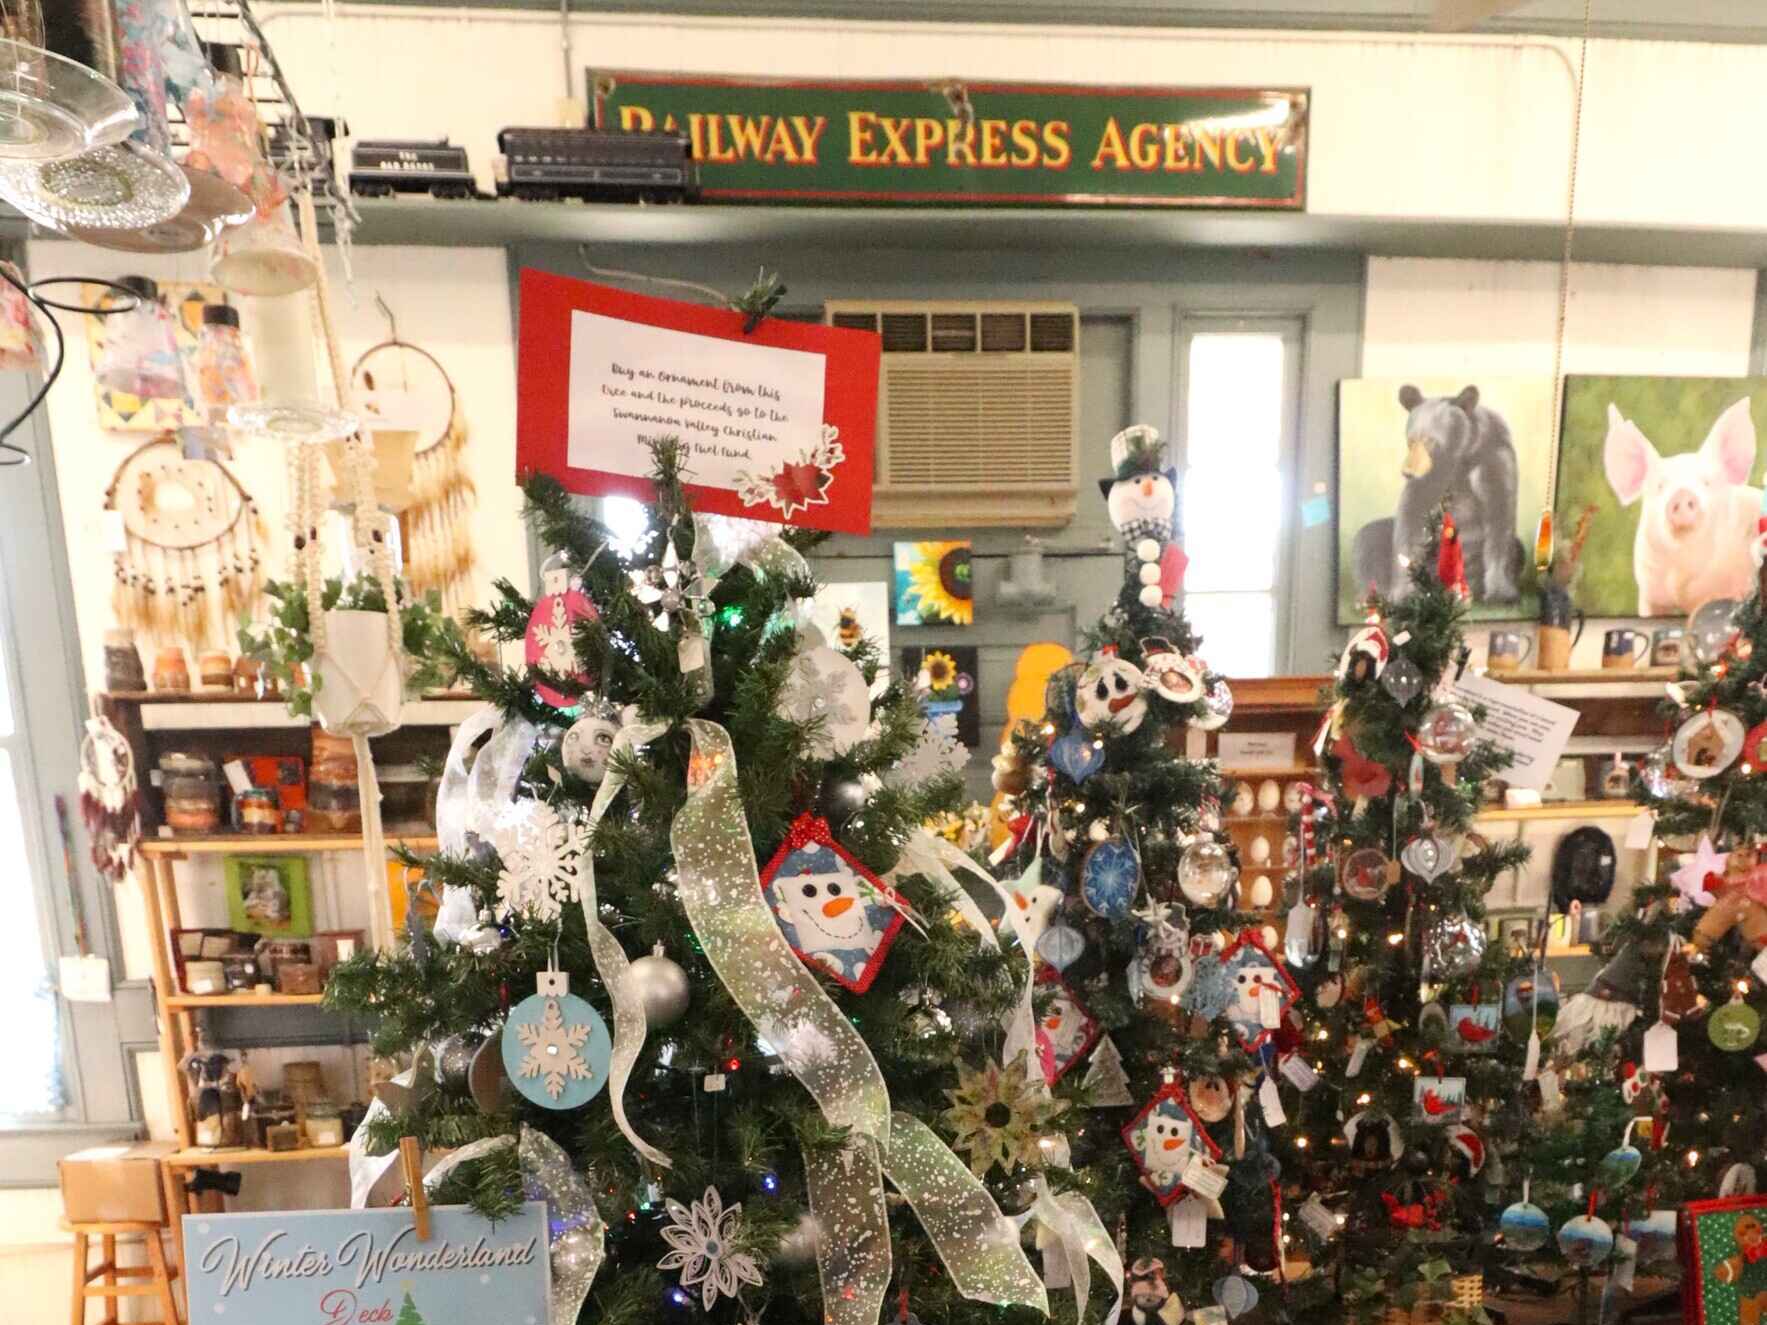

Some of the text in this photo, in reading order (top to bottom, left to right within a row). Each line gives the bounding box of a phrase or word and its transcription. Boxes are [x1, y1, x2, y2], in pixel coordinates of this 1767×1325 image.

[847, 111, 1073, 170] EXPRESS
[1091, 116, 1280, 174] AGENCY
[611, 363, 635, 380] Buy
[638, 369, 655, 379] an
[722, 380, 755, 395] from
[757, 384, 781, 401] this
[601, 384, 790, 422] tree and the proceeds go to the
[722, 424, 777, 441] Christian
[201, 1227, 536, 1297] Winter Wonderland
